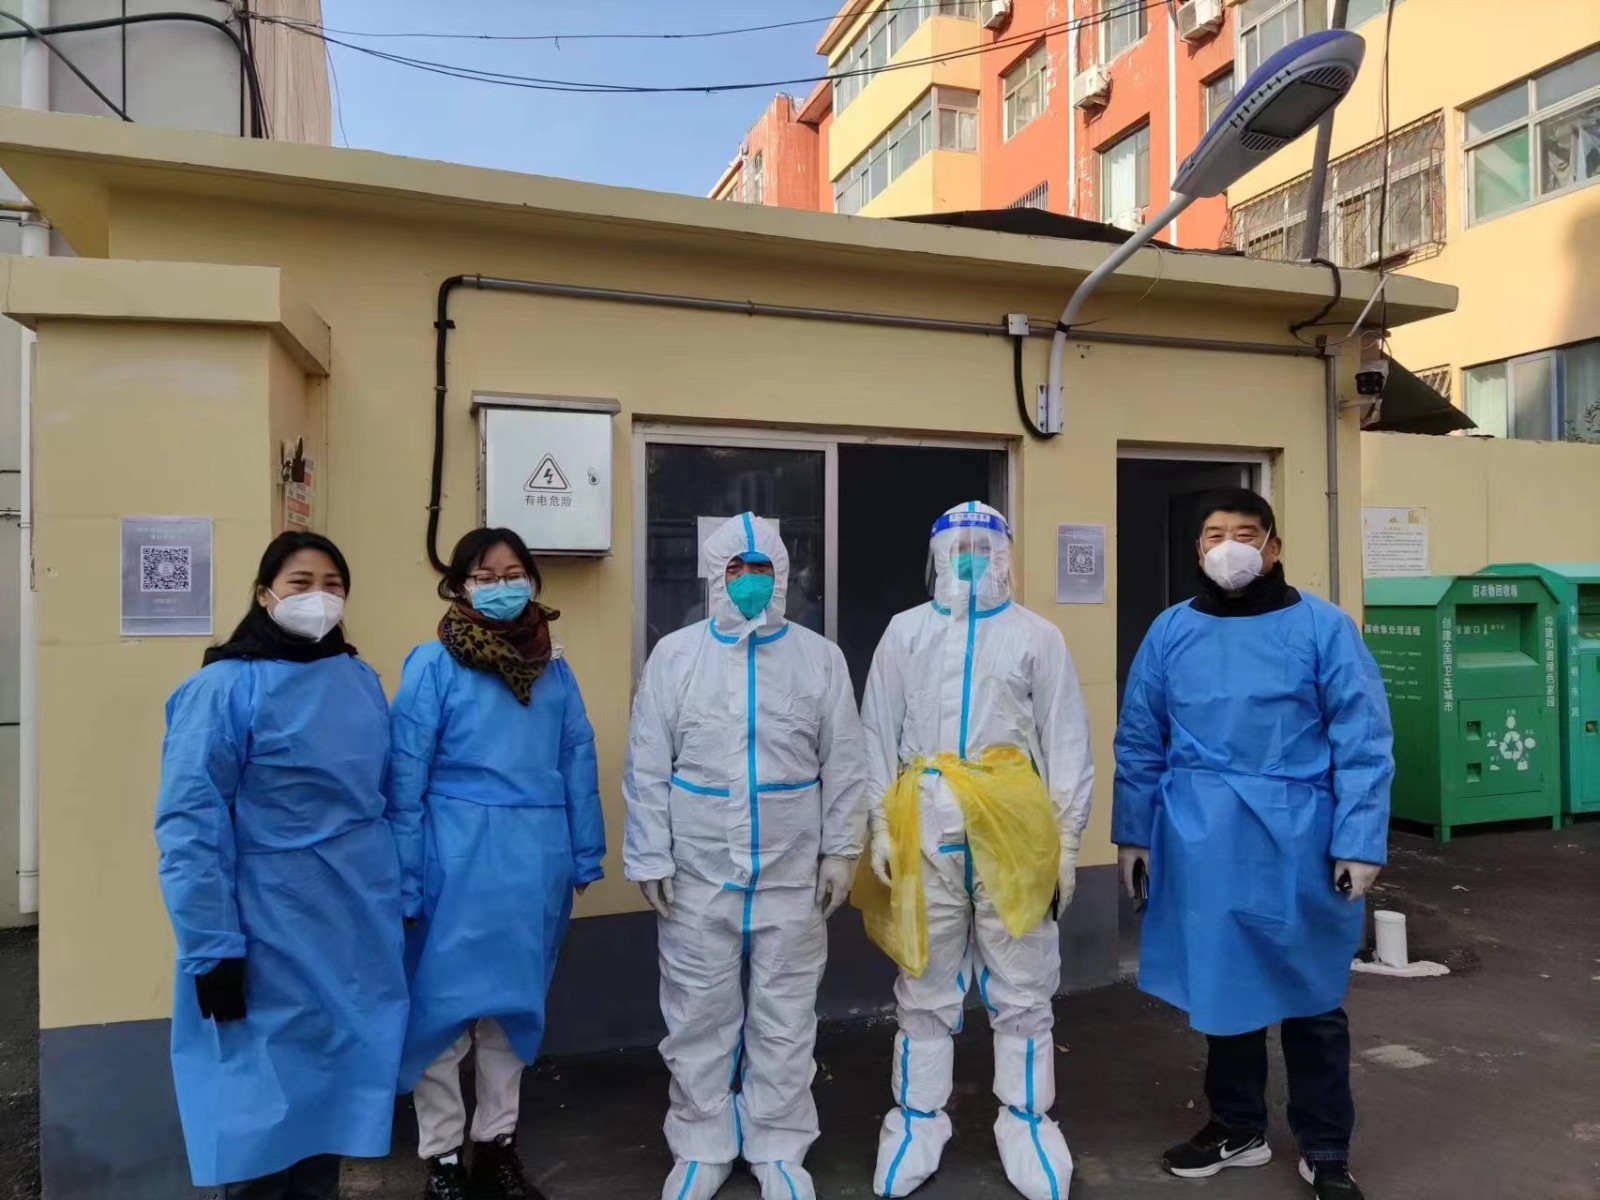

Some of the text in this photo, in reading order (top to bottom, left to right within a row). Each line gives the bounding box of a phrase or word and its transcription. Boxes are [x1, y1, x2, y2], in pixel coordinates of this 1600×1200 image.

[525, 494, 572, 507] 有电危险
[1472, 584, 1518, 597] 旧衣物回收箱
[1442, 617, 1453, 712] 创建全国卫生城市
